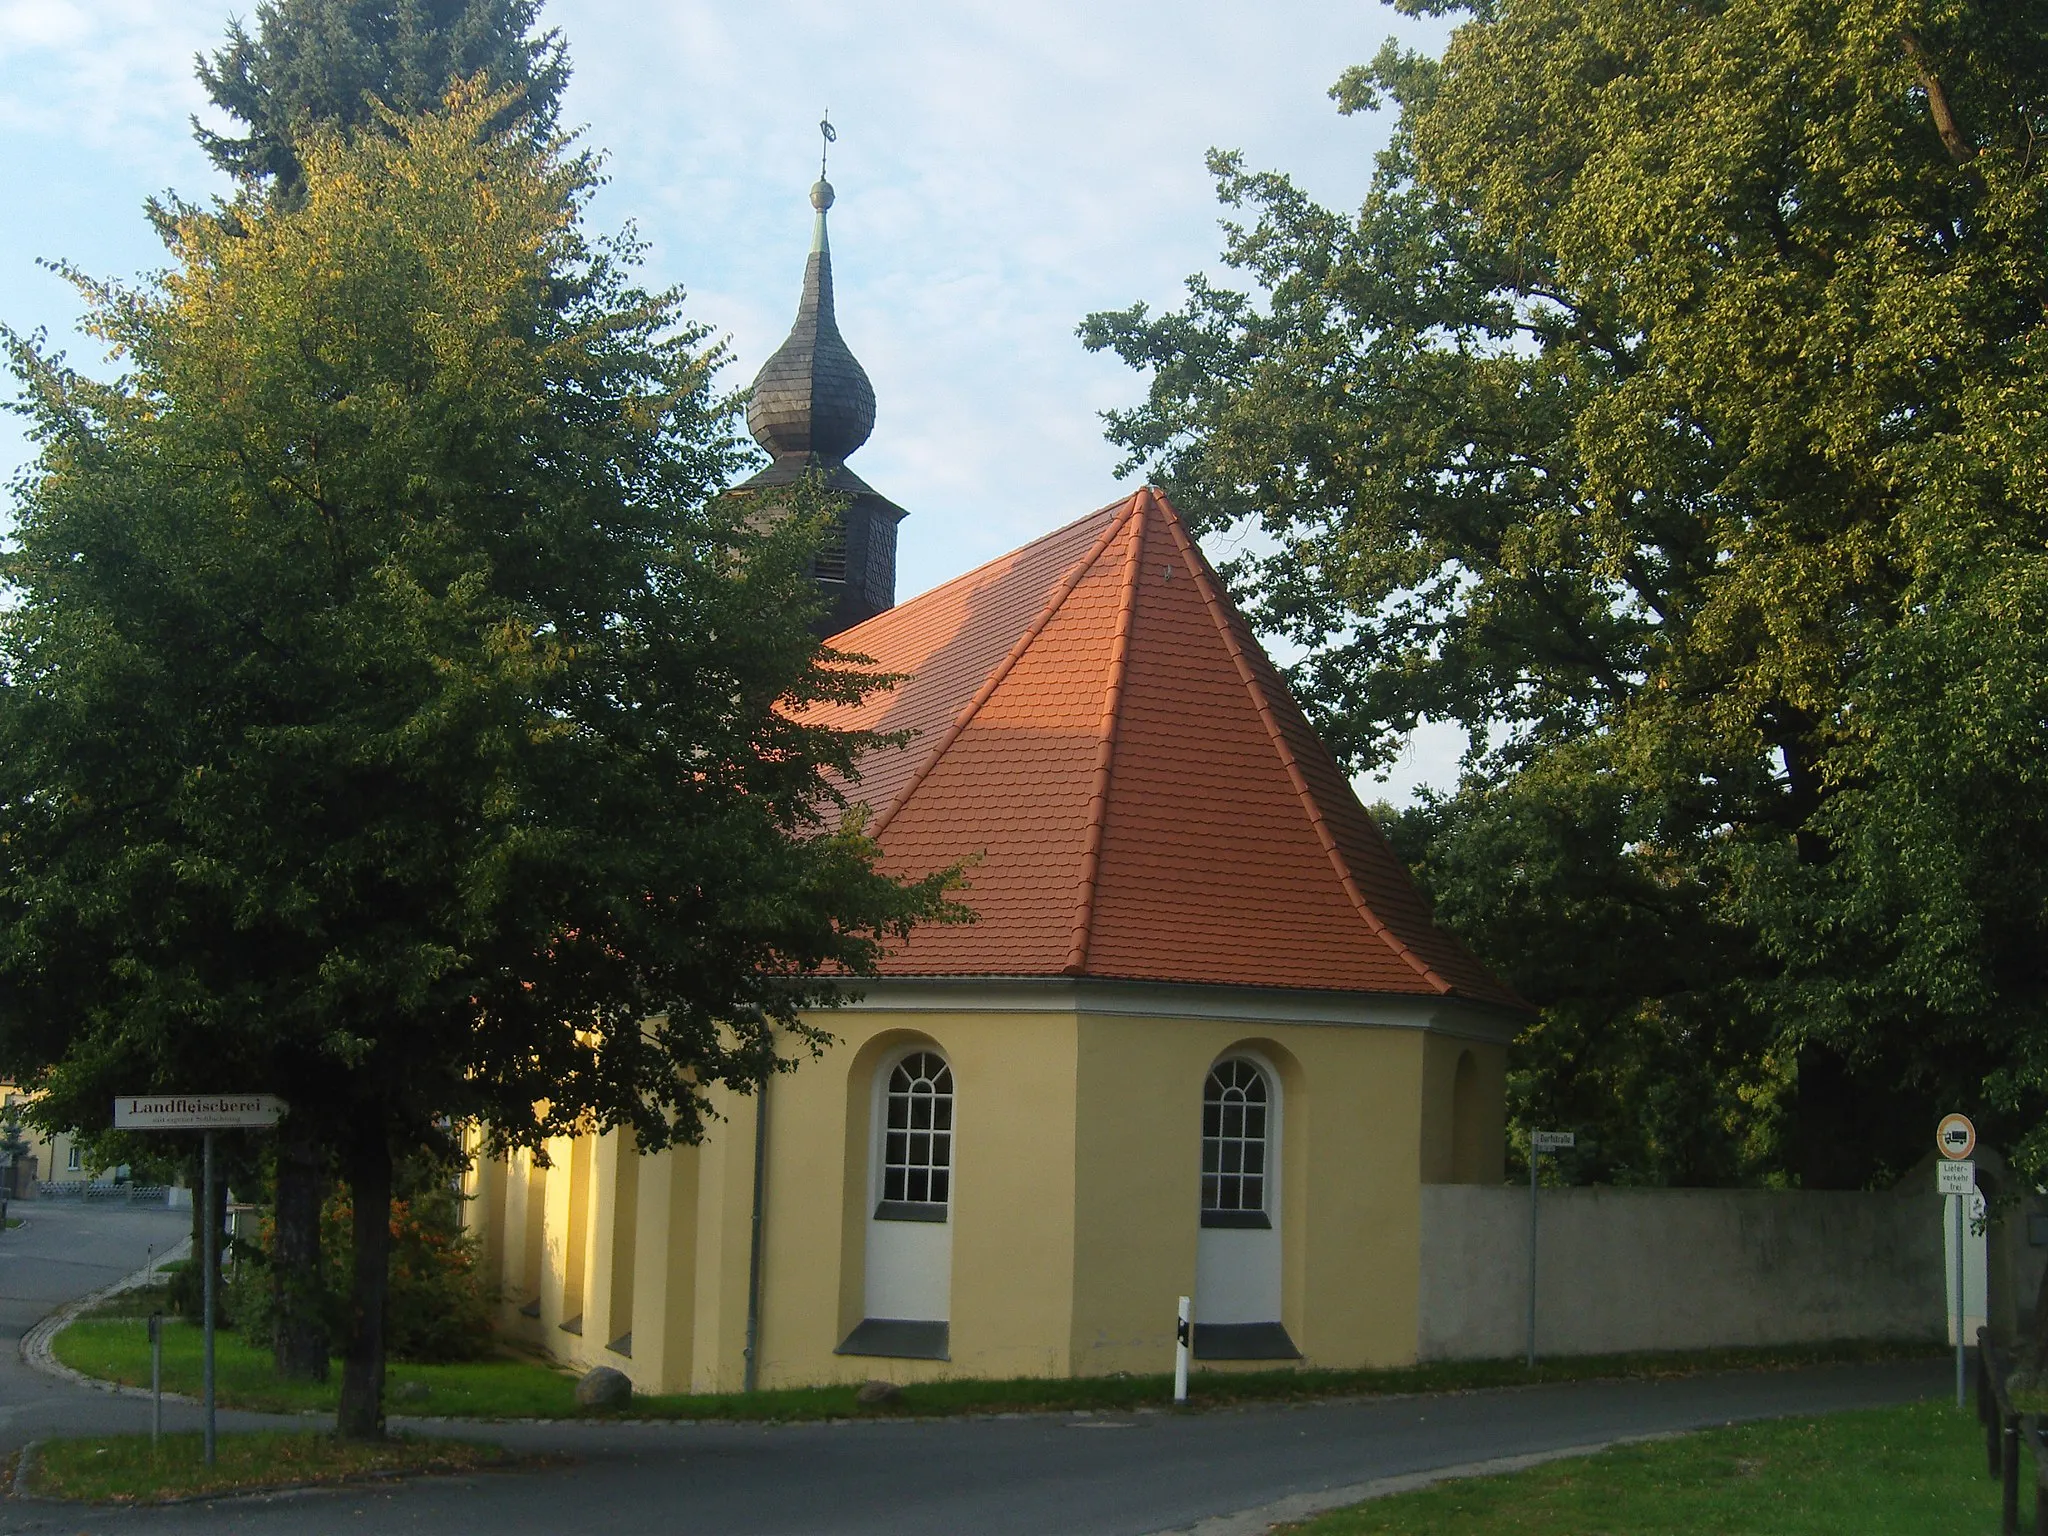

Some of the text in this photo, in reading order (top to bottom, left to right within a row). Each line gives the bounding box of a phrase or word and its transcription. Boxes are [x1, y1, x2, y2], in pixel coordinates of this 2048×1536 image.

[129, 1098, 260, 1114] Landfleischerei
[1540, 1133, 1571, 1144] Dorfstraße
[1944, 1164, 1968, 1172] Liefer-
[1942, 1173, 1968, 1182] verkehr
[1950, 1182, 1962, 1191] frei
